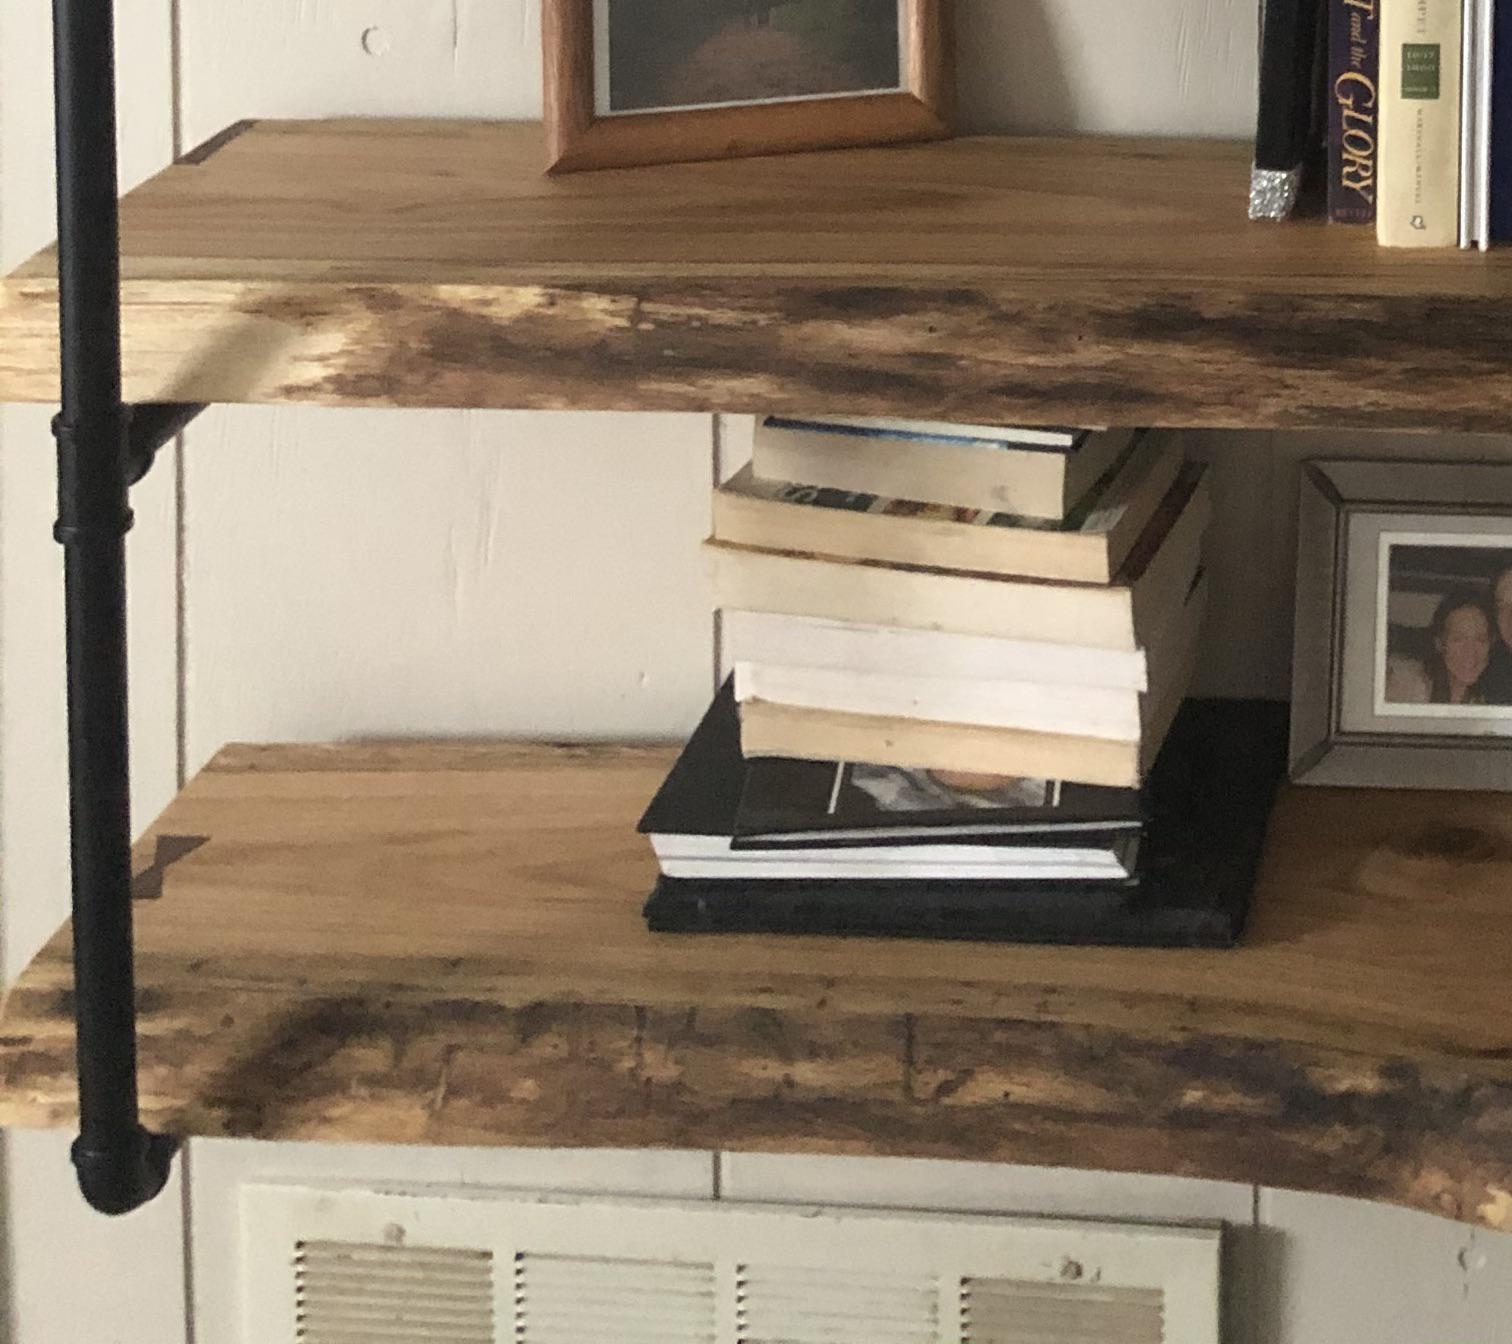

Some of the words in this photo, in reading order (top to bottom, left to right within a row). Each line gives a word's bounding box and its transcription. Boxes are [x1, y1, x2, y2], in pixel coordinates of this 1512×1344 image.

[1350, 12, 1367, 45] and
[1350, 46, 1367, 69] the
[1334, 71, 1376, 204] GLORY
